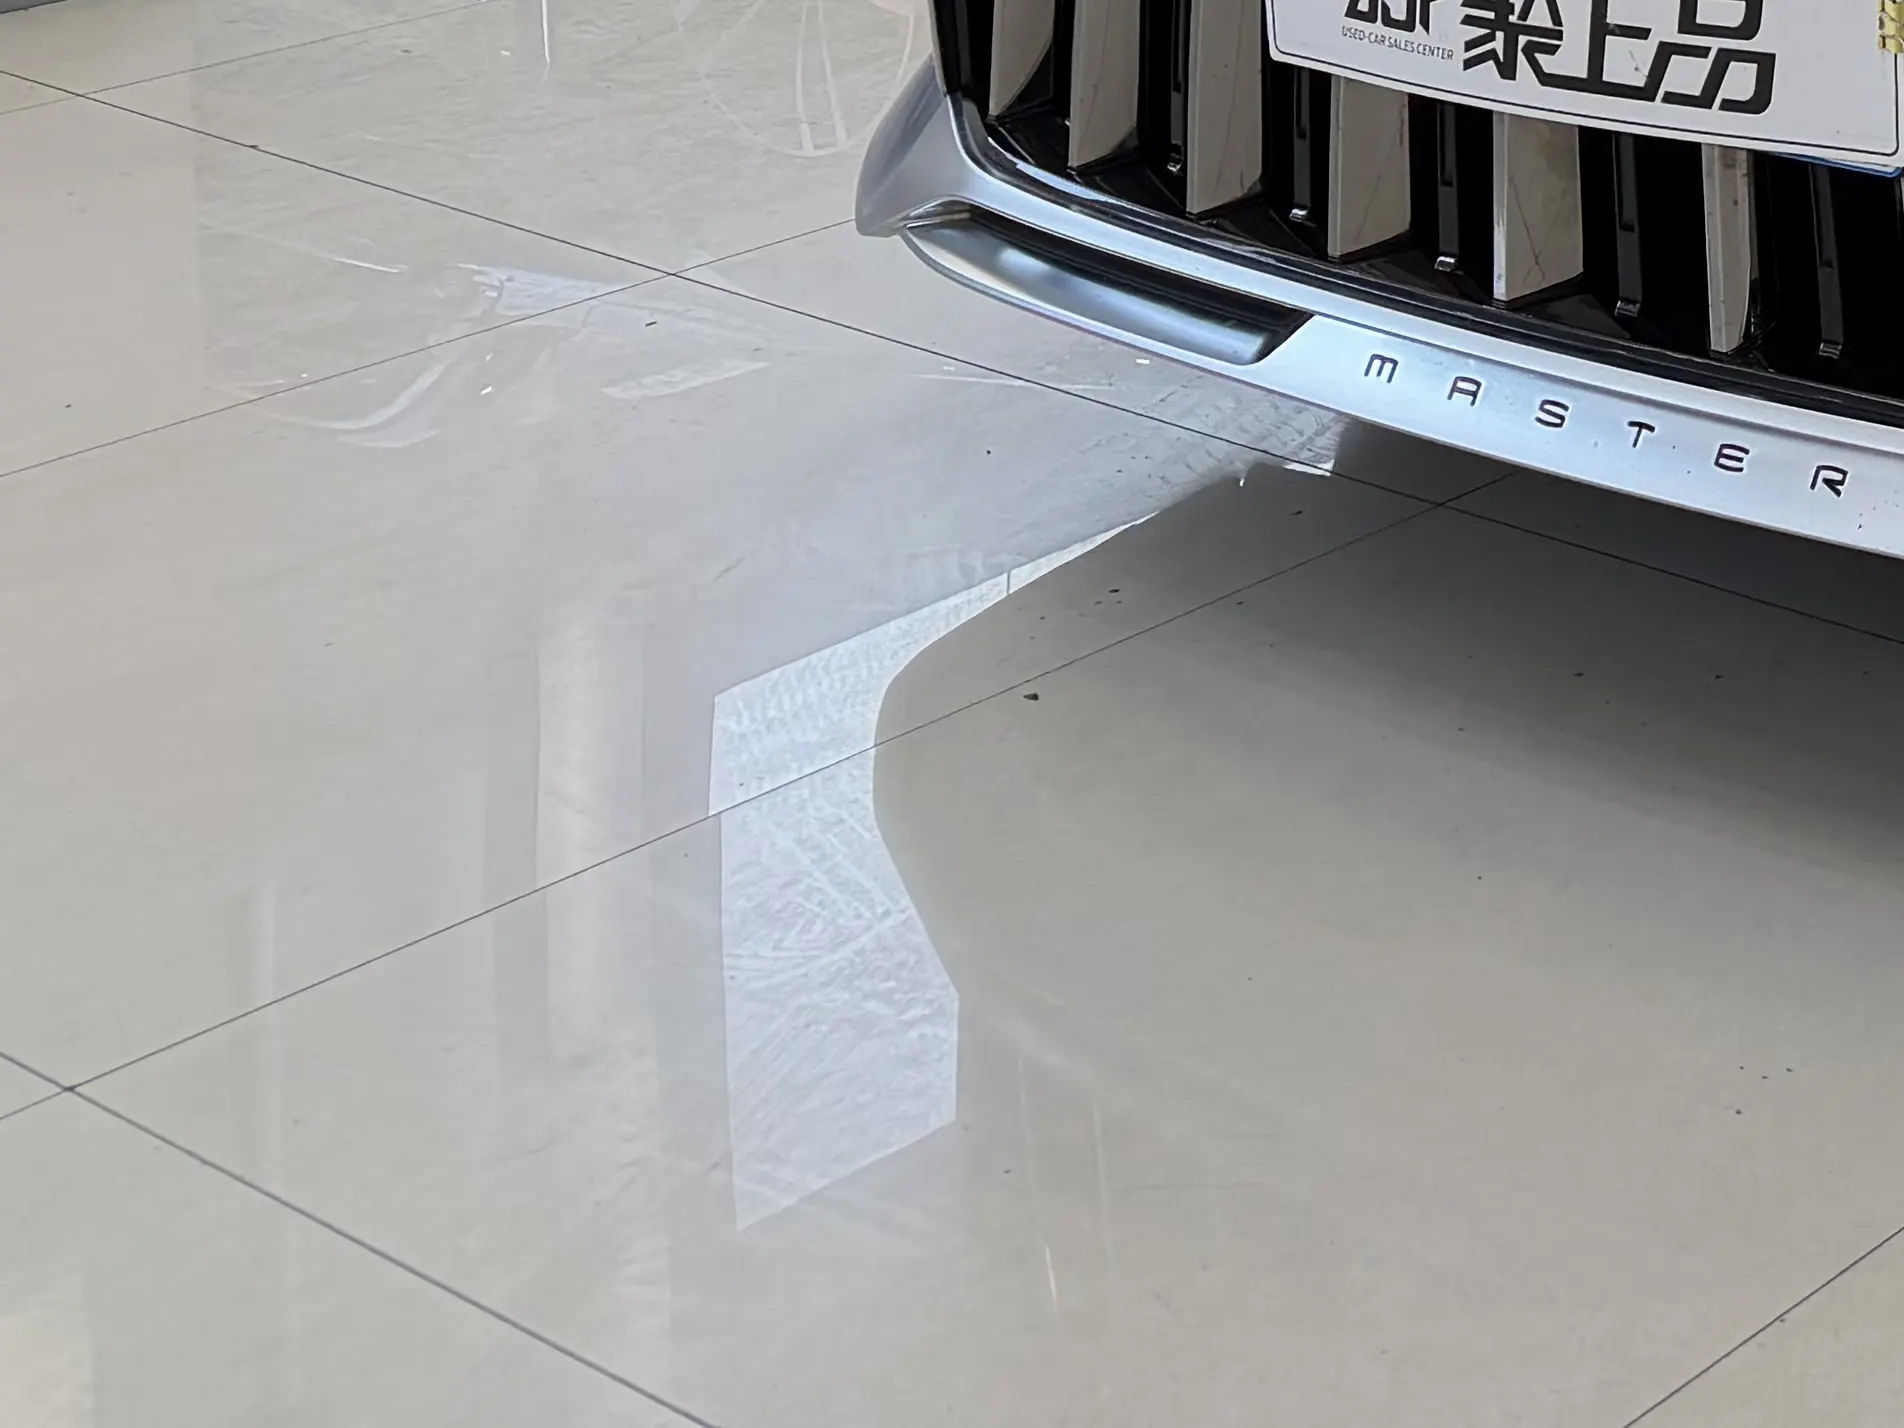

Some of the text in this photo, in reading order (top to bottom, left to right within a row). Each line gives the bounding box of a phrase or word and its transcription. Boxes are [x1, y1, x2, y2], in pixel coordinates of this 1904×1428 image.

[1387, 36, 1415, 53] SALES
[1416, 43, 1455, 61] CENTER
[1363, 352, 1850, 498] MASTER
